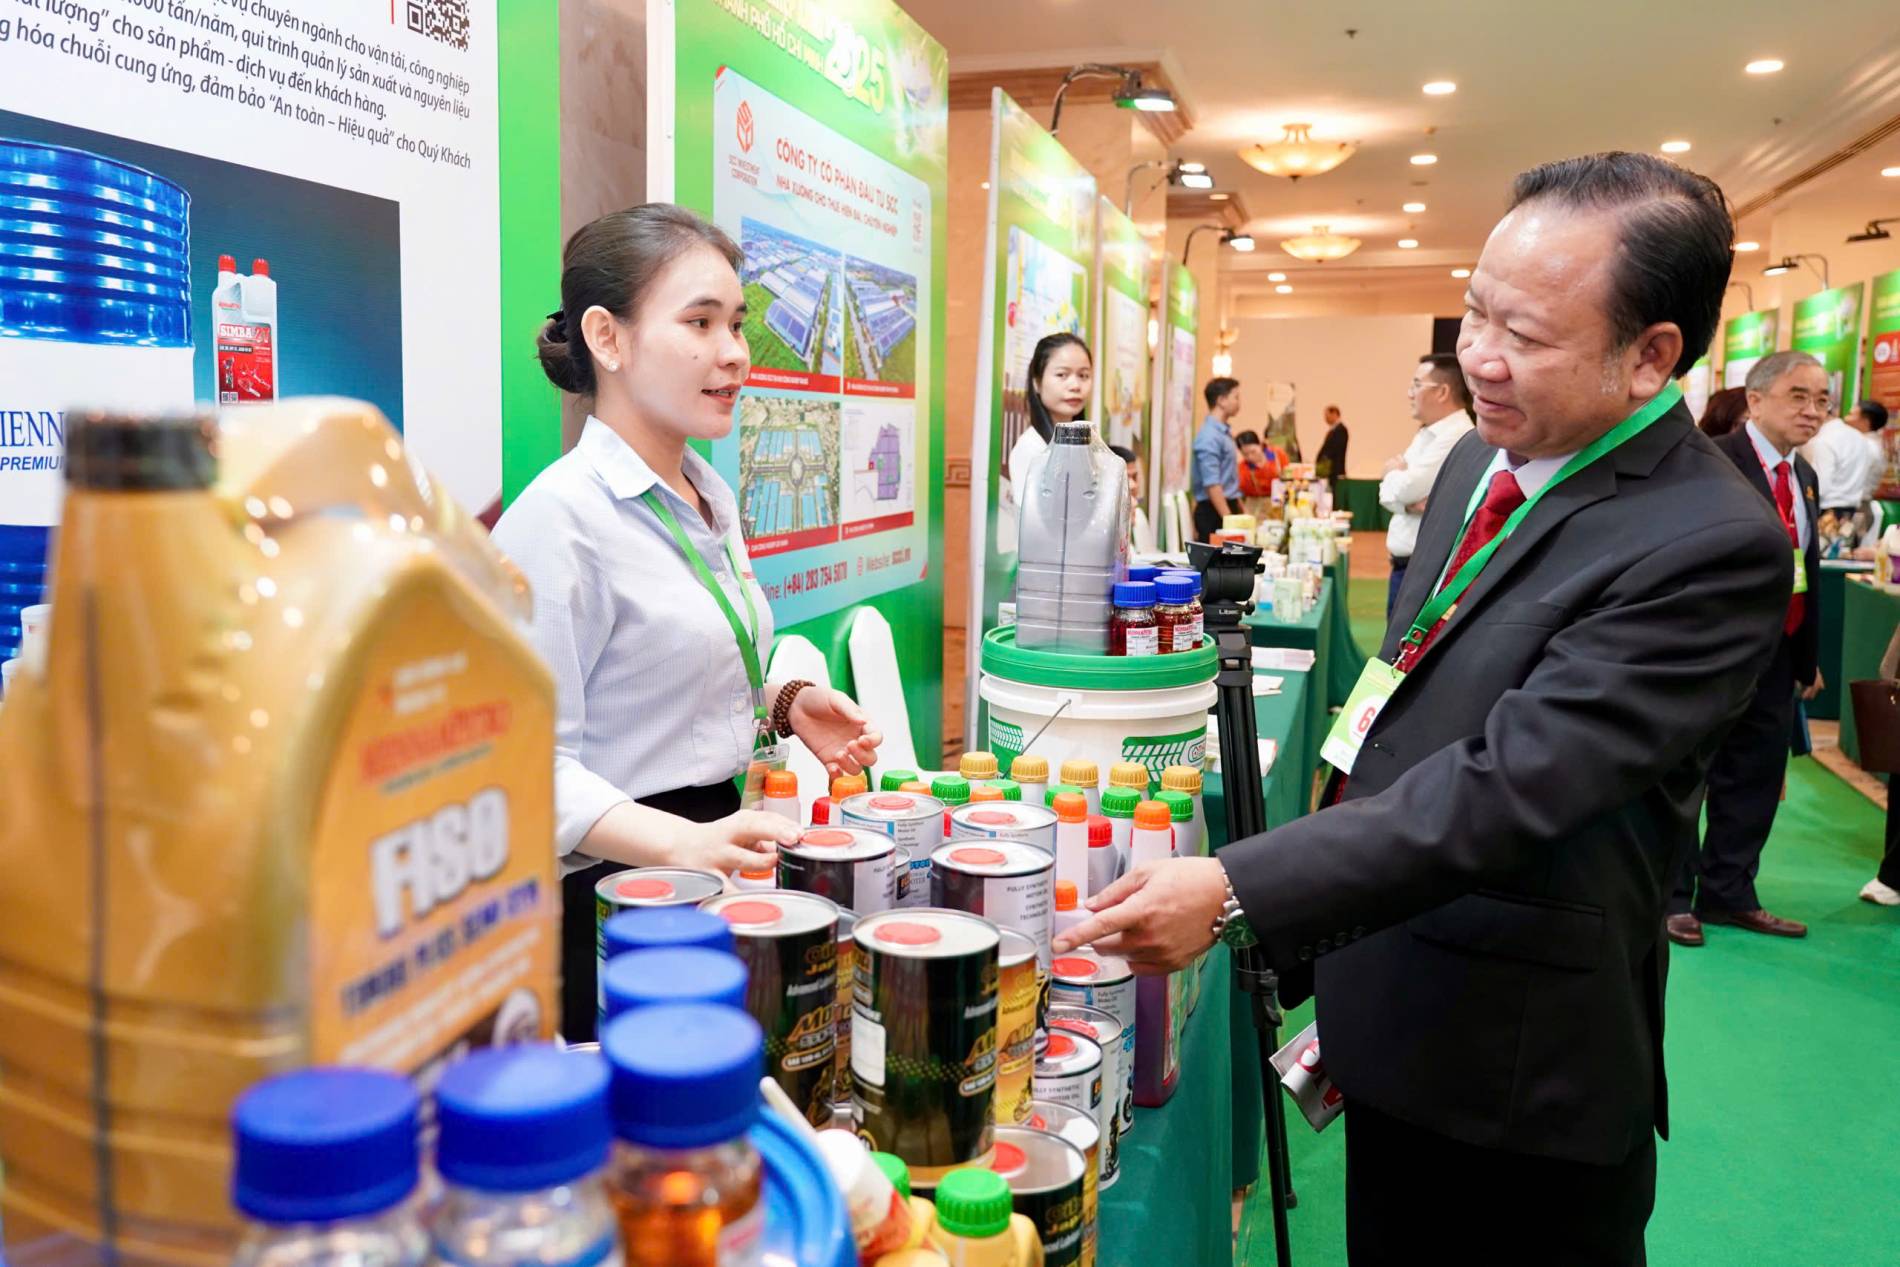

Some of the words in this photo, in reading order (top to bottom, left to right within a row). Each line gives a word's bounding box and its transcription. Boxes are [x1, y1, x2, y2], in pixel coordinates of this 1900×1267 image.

[16, 17, 55, 49] hóa
[60, 33, 111, 65] chuỗi
[115, 53, 157, 84] cung
[161, 62, 196, 93] ứng,
[200, 74, 234, 101] đảm
[238, 84, 266, 109] bảo
[295, 104, 325, 127] toàn
[338, 115, 365, 141] Hiệu
[396, 134, 416, 152] cho
[418, 139, 438, 163] Quý
[441, 147, 471, 168] Khách
[112, 15, 144, 41] cho
[147, 26, 176, 52] sản
[179, 37, 225, 67] phẩm
[236, 54, 266, 80] dịch
[269, 68, 285, 90] vụ
[288, 71, 312, 94] đến
[315, 78, 351, 107] khách
[354, 91, 387, 120] hàng.
[241, 29, 264, 48] qui
[267, 34, 299, 61] trình
[301, 49, 334, 73] quản
[336, 57, 347, 80] lý
[350, 63, 370, 85] sản
[372, 74, 397, 97] xuất
[399, 82, 412, 98] và
[414, 90, 451, 112] nguyên
[453, 98, 470, 120] liệu
[302, 22, 342, 47] ngành
[345, 34, 366, 56] cho
[368, 44, 389, 66] vận
[391, 50, 407, 73] tải,
[409, 60, 435, 85] công
[436, 70, 470, 97] nghiệp
[776, 136, 805, 170] CÔNG
[807, 153, 818, 177] TY
